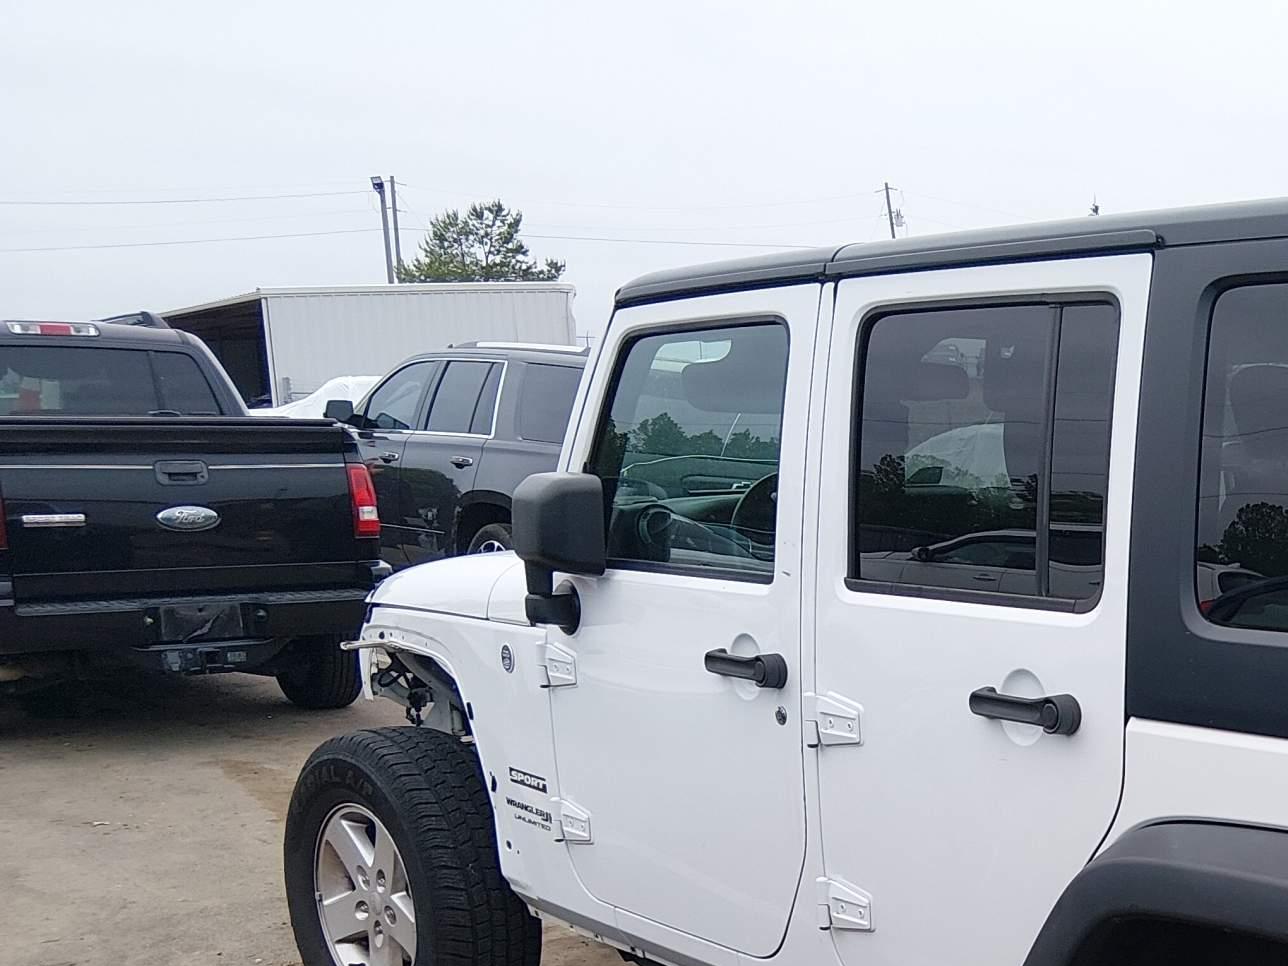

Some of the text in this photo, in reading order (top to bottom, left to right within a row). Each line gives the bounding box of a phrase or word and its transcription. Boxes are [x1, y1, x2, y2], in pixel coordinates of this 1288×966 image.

[510, 768, 546, 792] SPORT
[506, 796, 547, 818] WRANGLER
[514, 813, 552, 832] UNLIMITED
